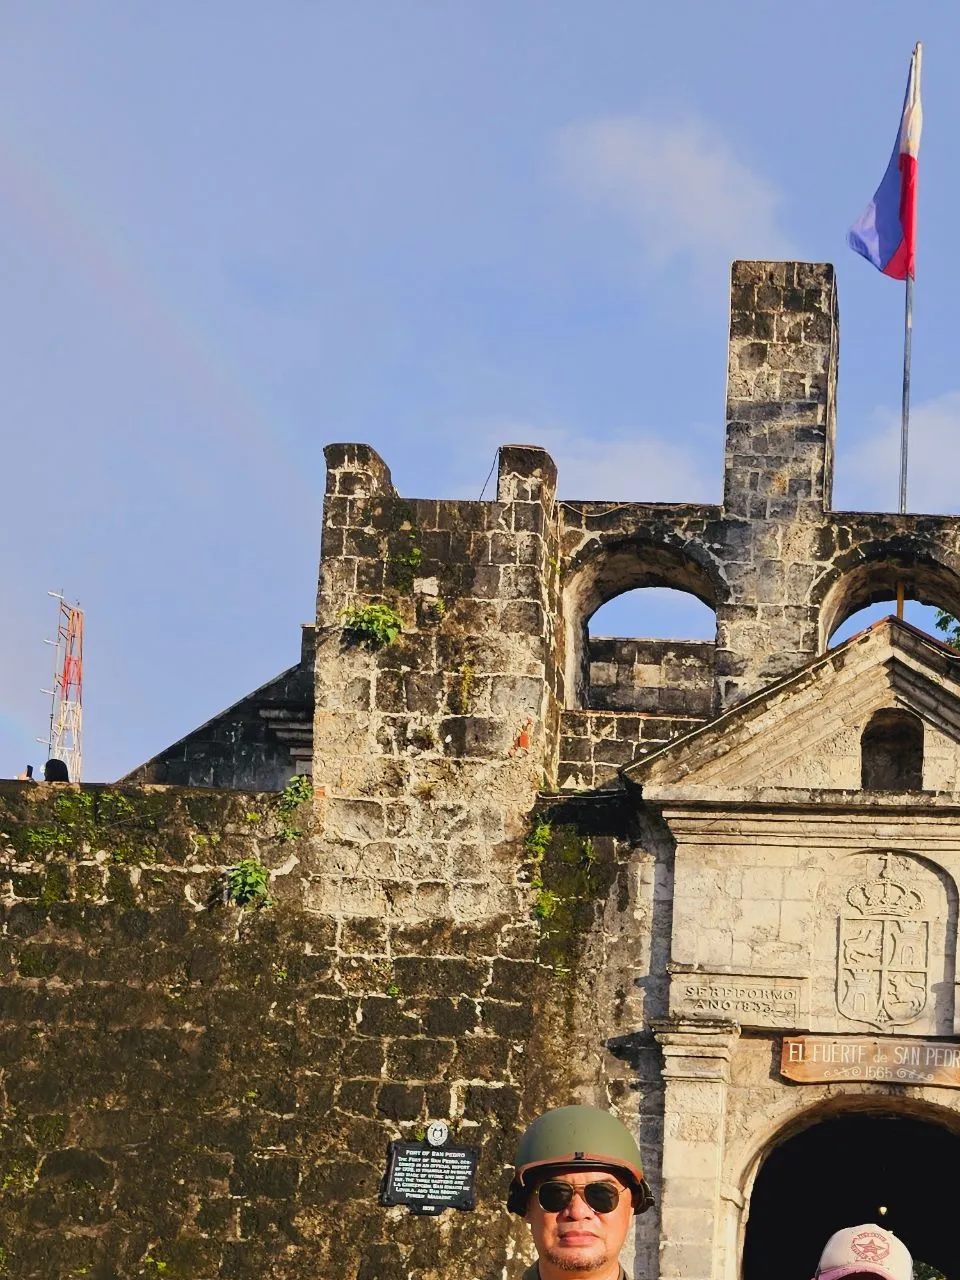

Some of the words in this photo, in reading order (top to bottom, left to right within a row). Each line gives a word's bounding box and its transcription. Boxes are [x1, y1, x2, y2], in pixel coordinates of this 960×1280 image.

[789, 1044, 805, 1062] EL
[813, 1044, 867, 1064] FUERTE
[873, 1050, 888, 1063] de
[894, 1047, 920, 1065] SAN
[865, 1067, 893, 1080] 1565
